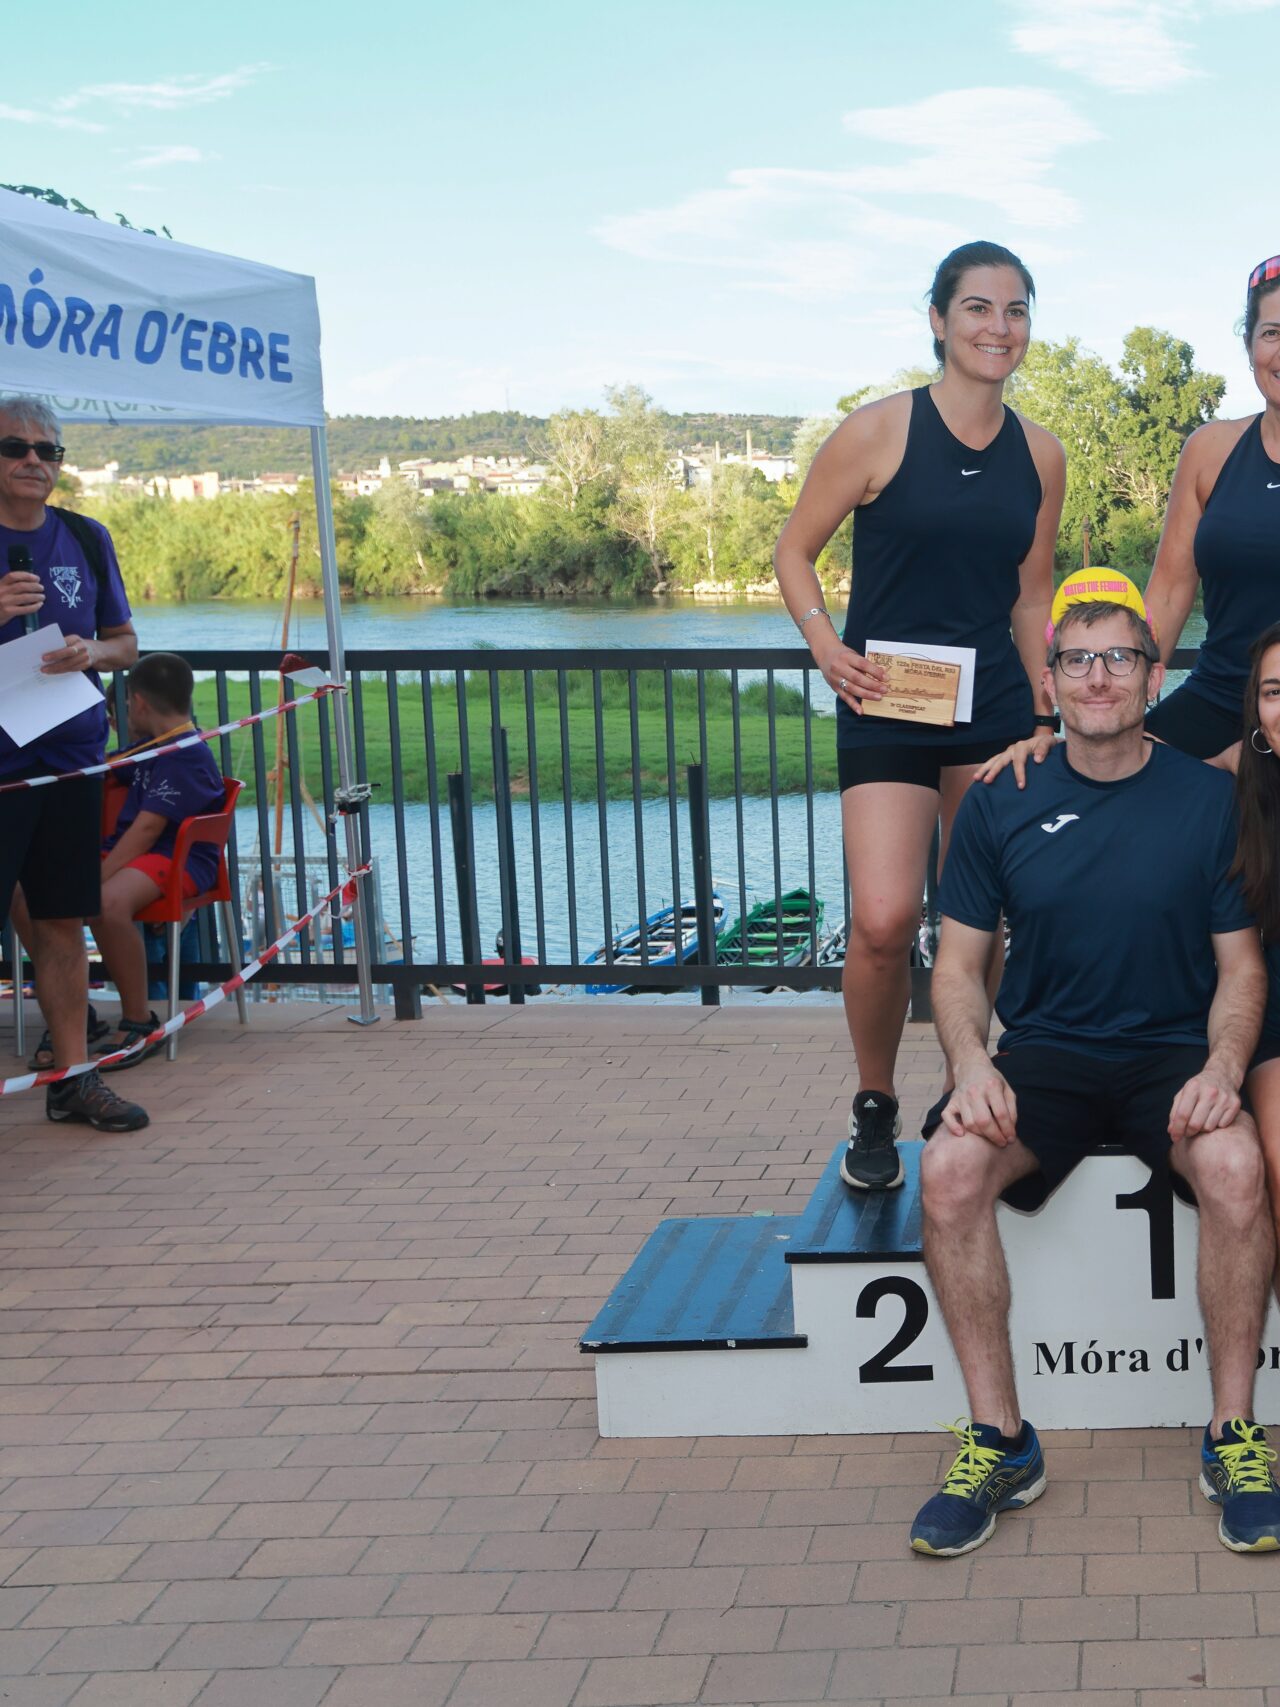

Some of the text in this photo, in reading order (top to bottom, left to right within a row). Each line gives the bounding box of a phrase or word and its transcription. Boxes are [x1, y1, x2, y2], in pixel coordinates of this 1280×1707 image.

[135, 311, 293, 383] D'EBRE
[1064, 582, 1086, 596] WATCH
[1087, 581, 1099, 592] THE
[911, 662, 931, 670] FESTA
[931, 665, 944, 673] DEL
[1116, 1158, 1175, 1299] 1
[855, 1276, 934, 1383] 2
[1032, 1340, 1150, 1375] Móra
